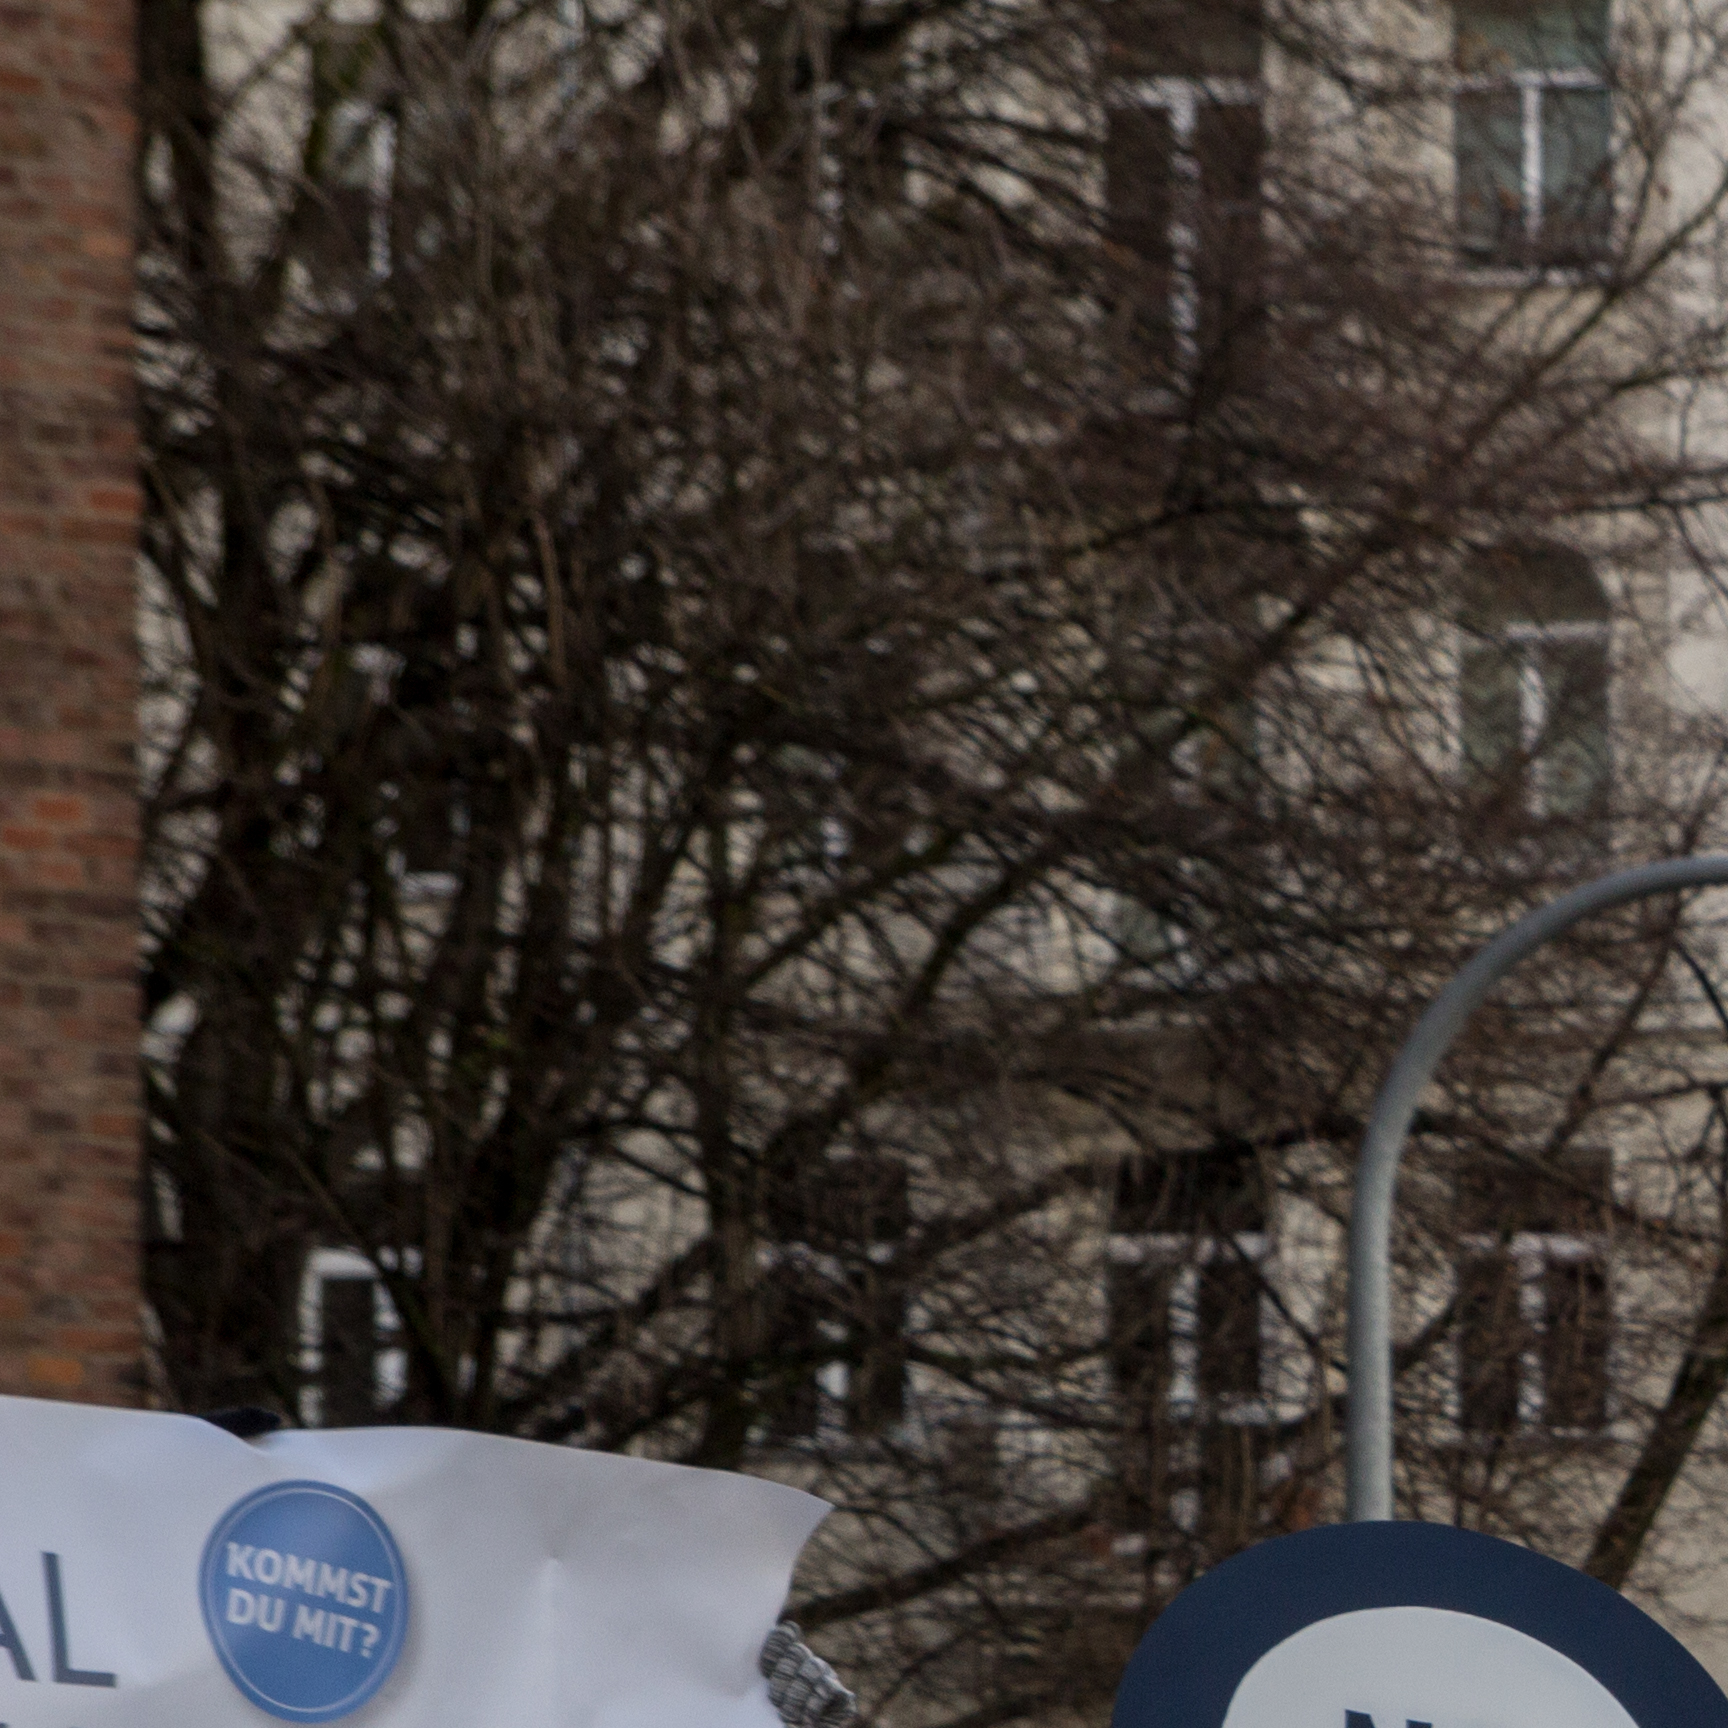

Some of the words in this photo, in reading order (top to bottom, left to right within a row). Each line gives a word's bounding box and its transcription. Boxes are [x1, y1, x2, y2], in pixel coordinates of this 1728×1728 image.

[226, 1542, 391, 1614] KOMMST
[226, 1588, 284, 1632] DU
[298, 1607, 380, 1659] MIT?
